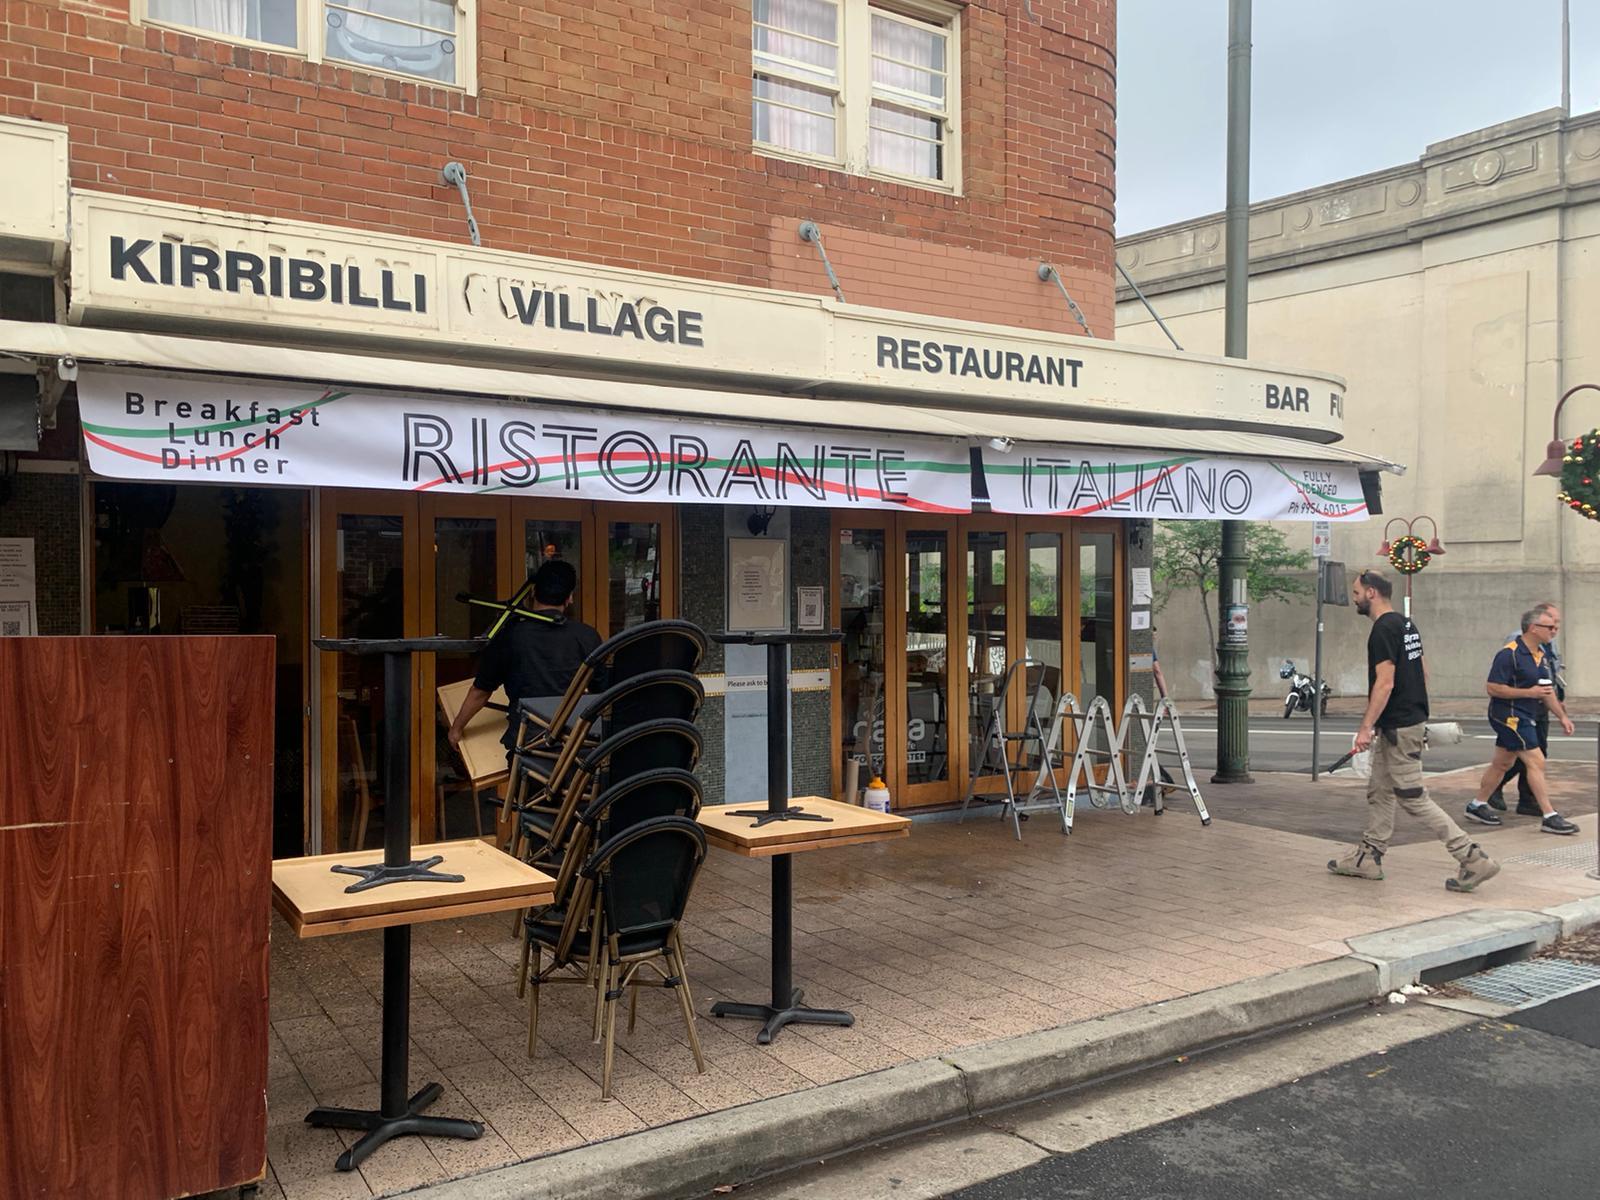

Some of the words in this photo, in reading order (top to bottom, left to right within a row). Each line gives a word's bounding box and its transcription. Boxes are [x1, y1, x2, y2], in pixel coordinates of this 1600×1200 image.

[110, 235, 427, 313] KIRRIBILLI
[510, 285, 704, 347] VILLAGE
[877, 335, 1083, 388] RESTAURANT
[126, 391, 320, 427] Breakfast
[1266, 383, 1309, 413] BAR
[168, 421, 281, 450] Lunch
[161, 447, 289, 475] Dinner
[402, 411, 908, 503] RISTORANTE
[1022, 456, 1252, 515] ITALIANO
[1303, 470, 1332, 483] FULLY
[1324, 503, 1348, 515] 6015
[746, 679, 756, 687] ask
